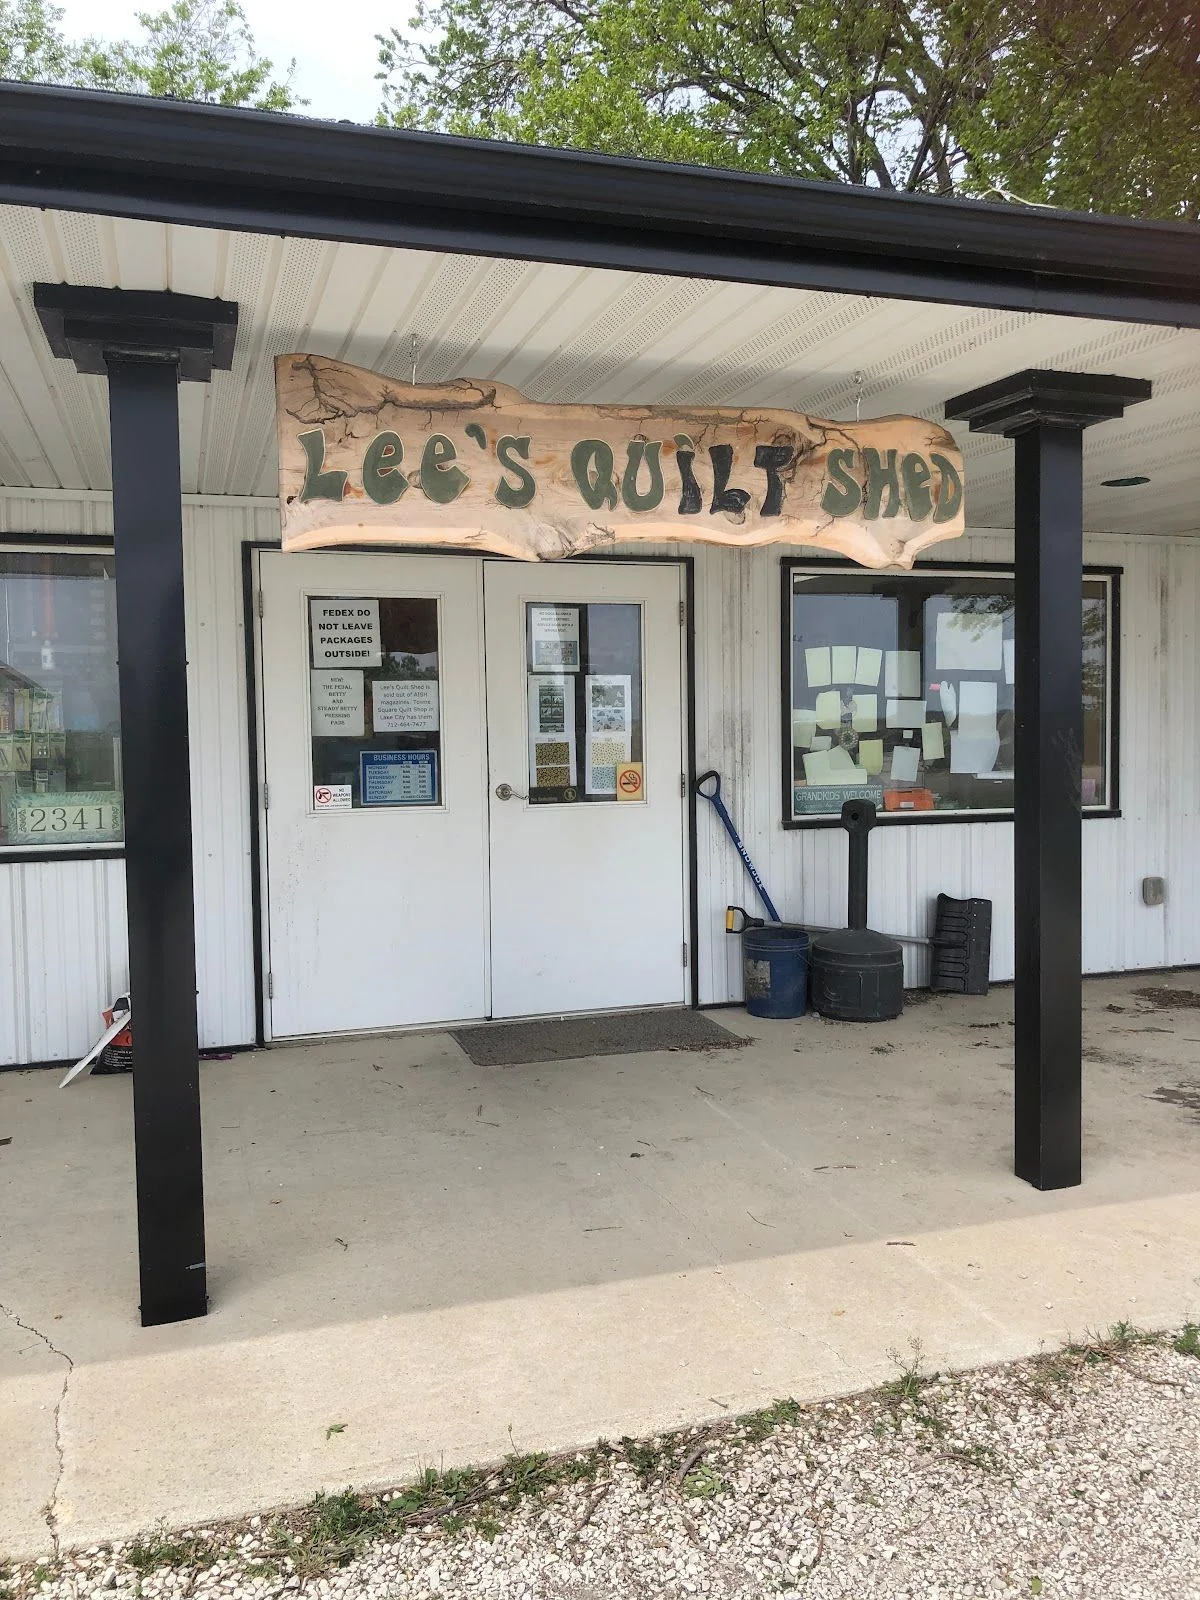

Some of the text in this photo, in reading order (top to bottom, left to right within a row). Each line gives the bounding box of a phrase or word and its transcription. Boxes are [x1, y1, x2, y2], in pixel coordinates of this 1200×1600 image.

[322, 609, 371, 617] FEDEX DO
[320, 637, 373, 645] PACKAGES
[324, 650, 370, 658] OUTSIDE!
[407, 753, 430, 761] HOURS
[795, 790, 881, 801] GRANDKIDS WELCOME
[30, 807, 108, 832] 2341
